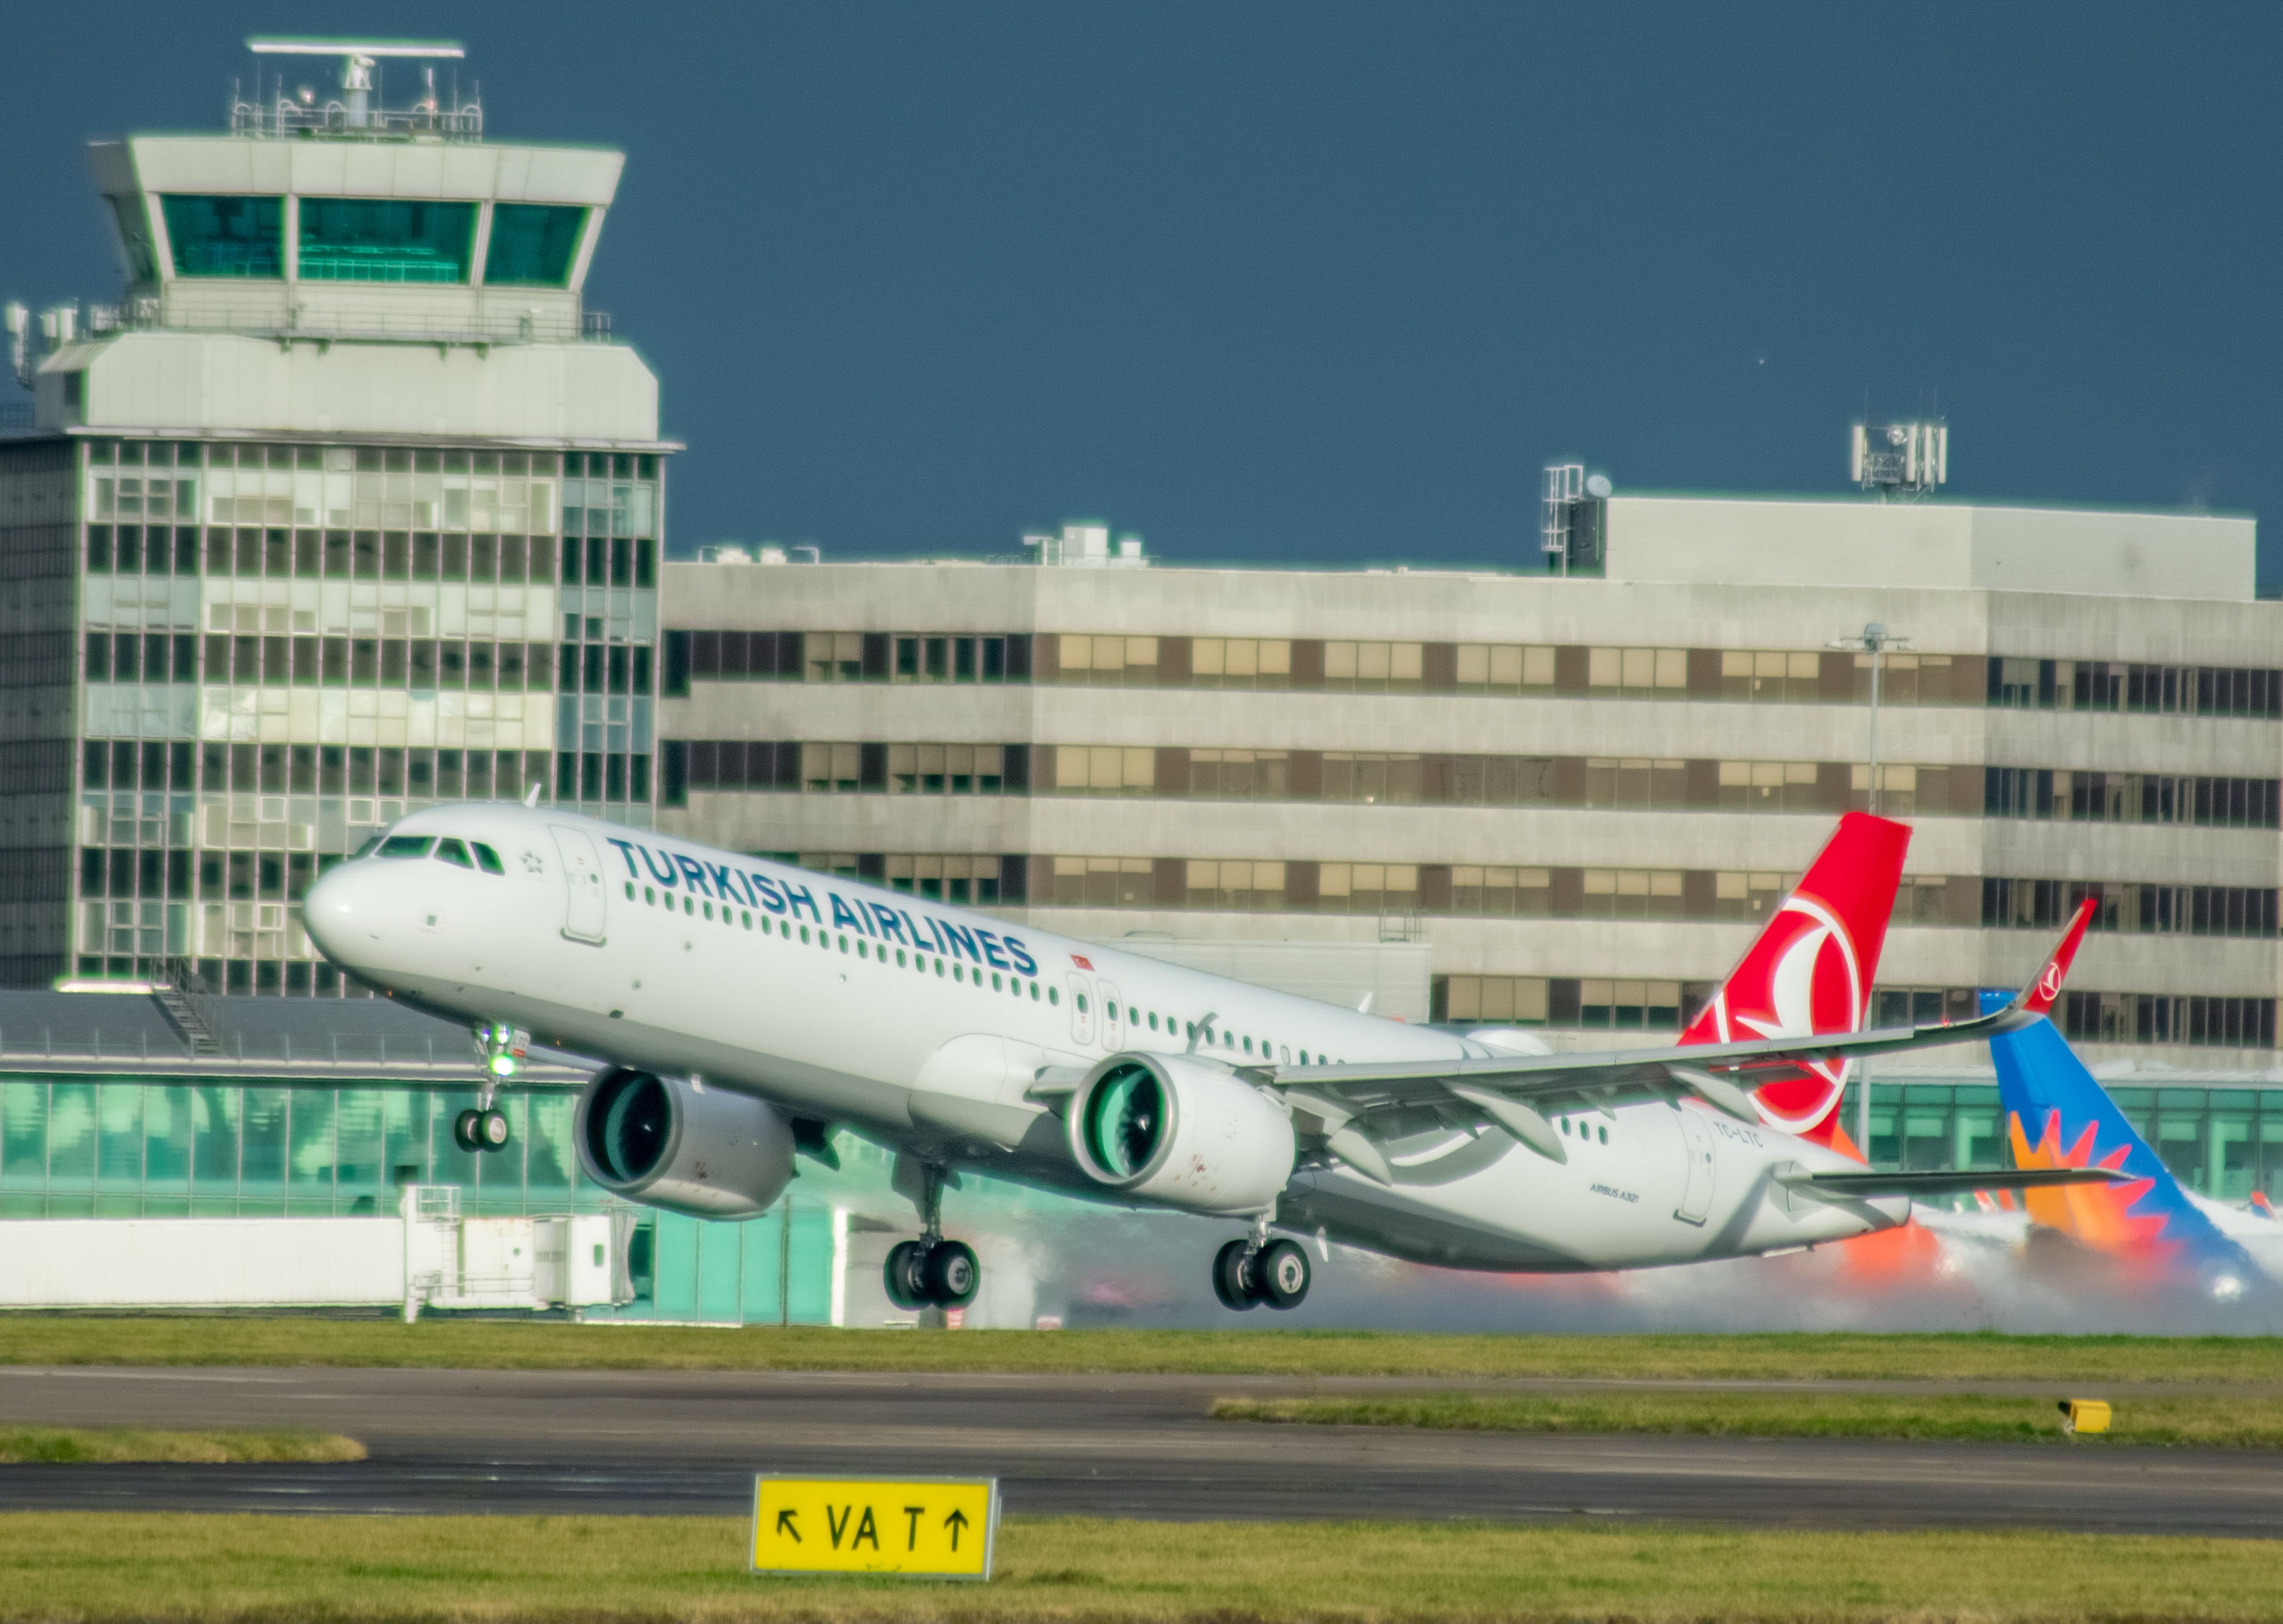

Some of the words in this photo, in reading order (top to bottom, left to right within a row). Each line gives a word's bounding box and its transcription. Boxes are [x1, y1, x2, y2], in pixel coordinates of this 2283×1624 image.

[606, 837, 823, 924] TURKISH
[832, 891, 1038, 977] AIRLINES
[1713, 1121, 1763, 1148] TC-LTC
[1590, 1183, 1619, 1198] AIRBUS
[826, 1505, 879, 1550] VA
[904, 1507, 925, 1552] T
